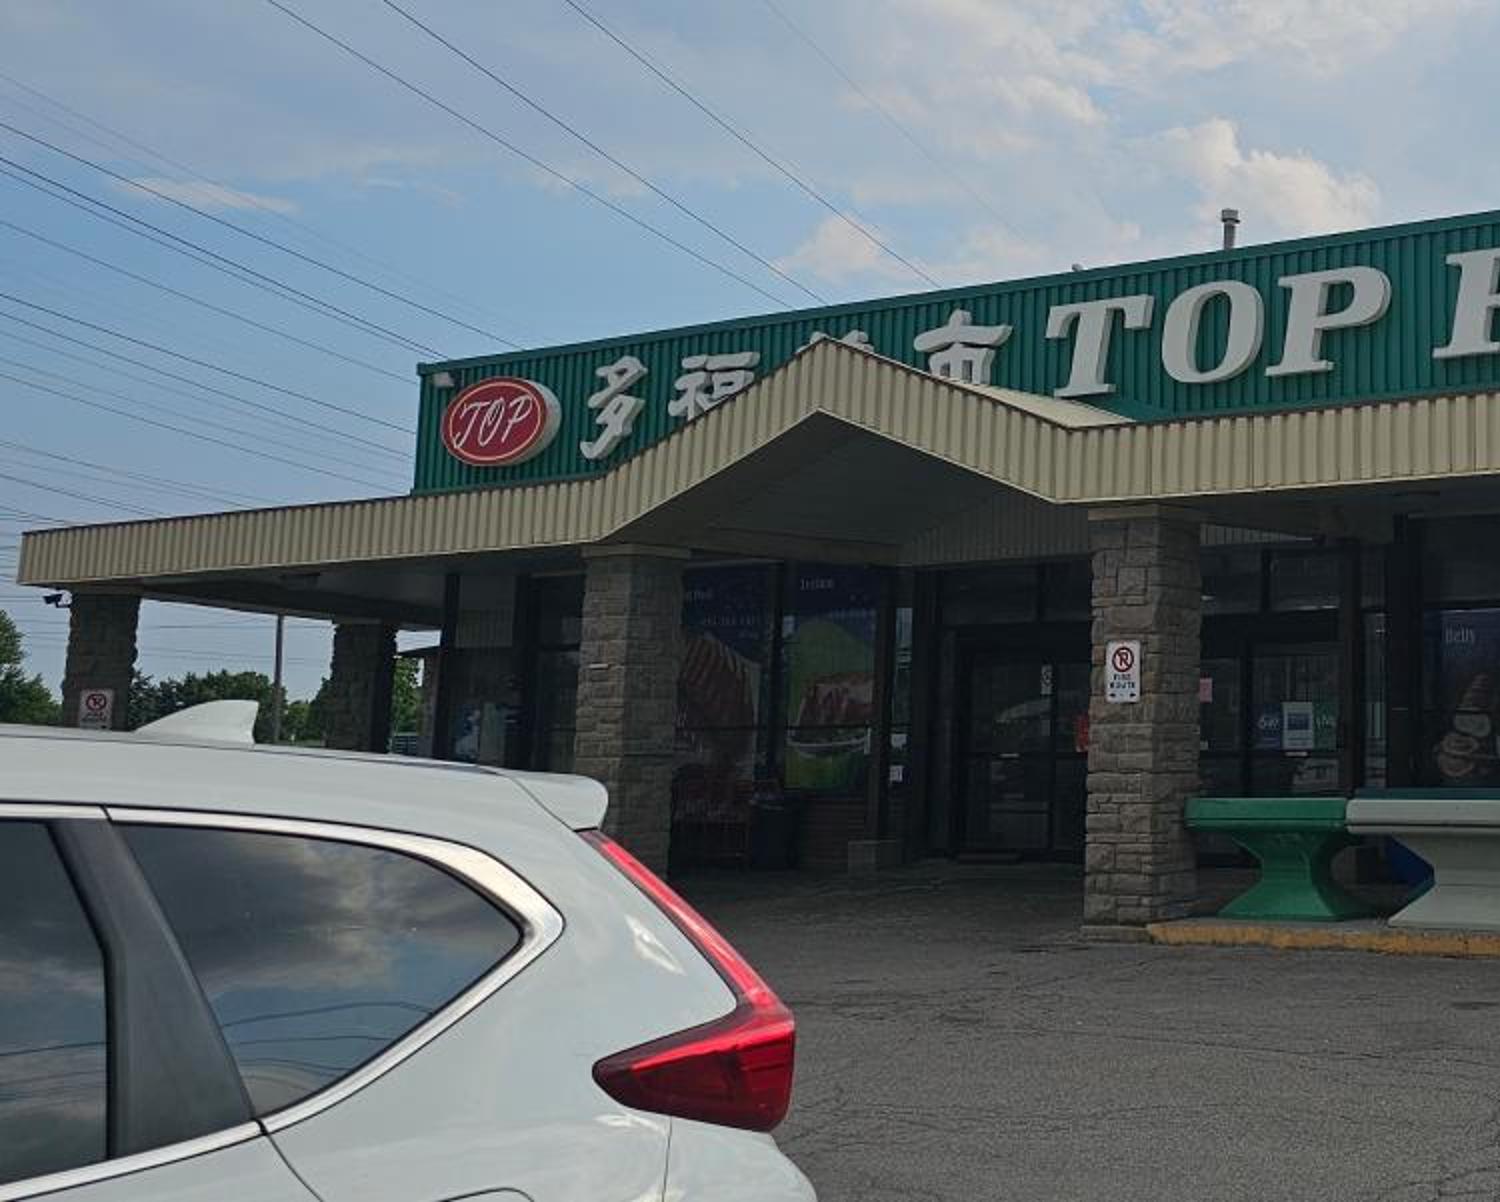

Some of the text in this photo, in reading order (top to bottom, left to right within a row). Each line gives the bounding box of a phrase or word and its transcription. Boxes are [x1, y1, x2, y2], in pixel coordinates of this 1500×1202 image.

[579, 309, 1013, 459] 多福市
[1044, 265, 1392, 399] TOP
[453, 394, 533, 449] TOP
